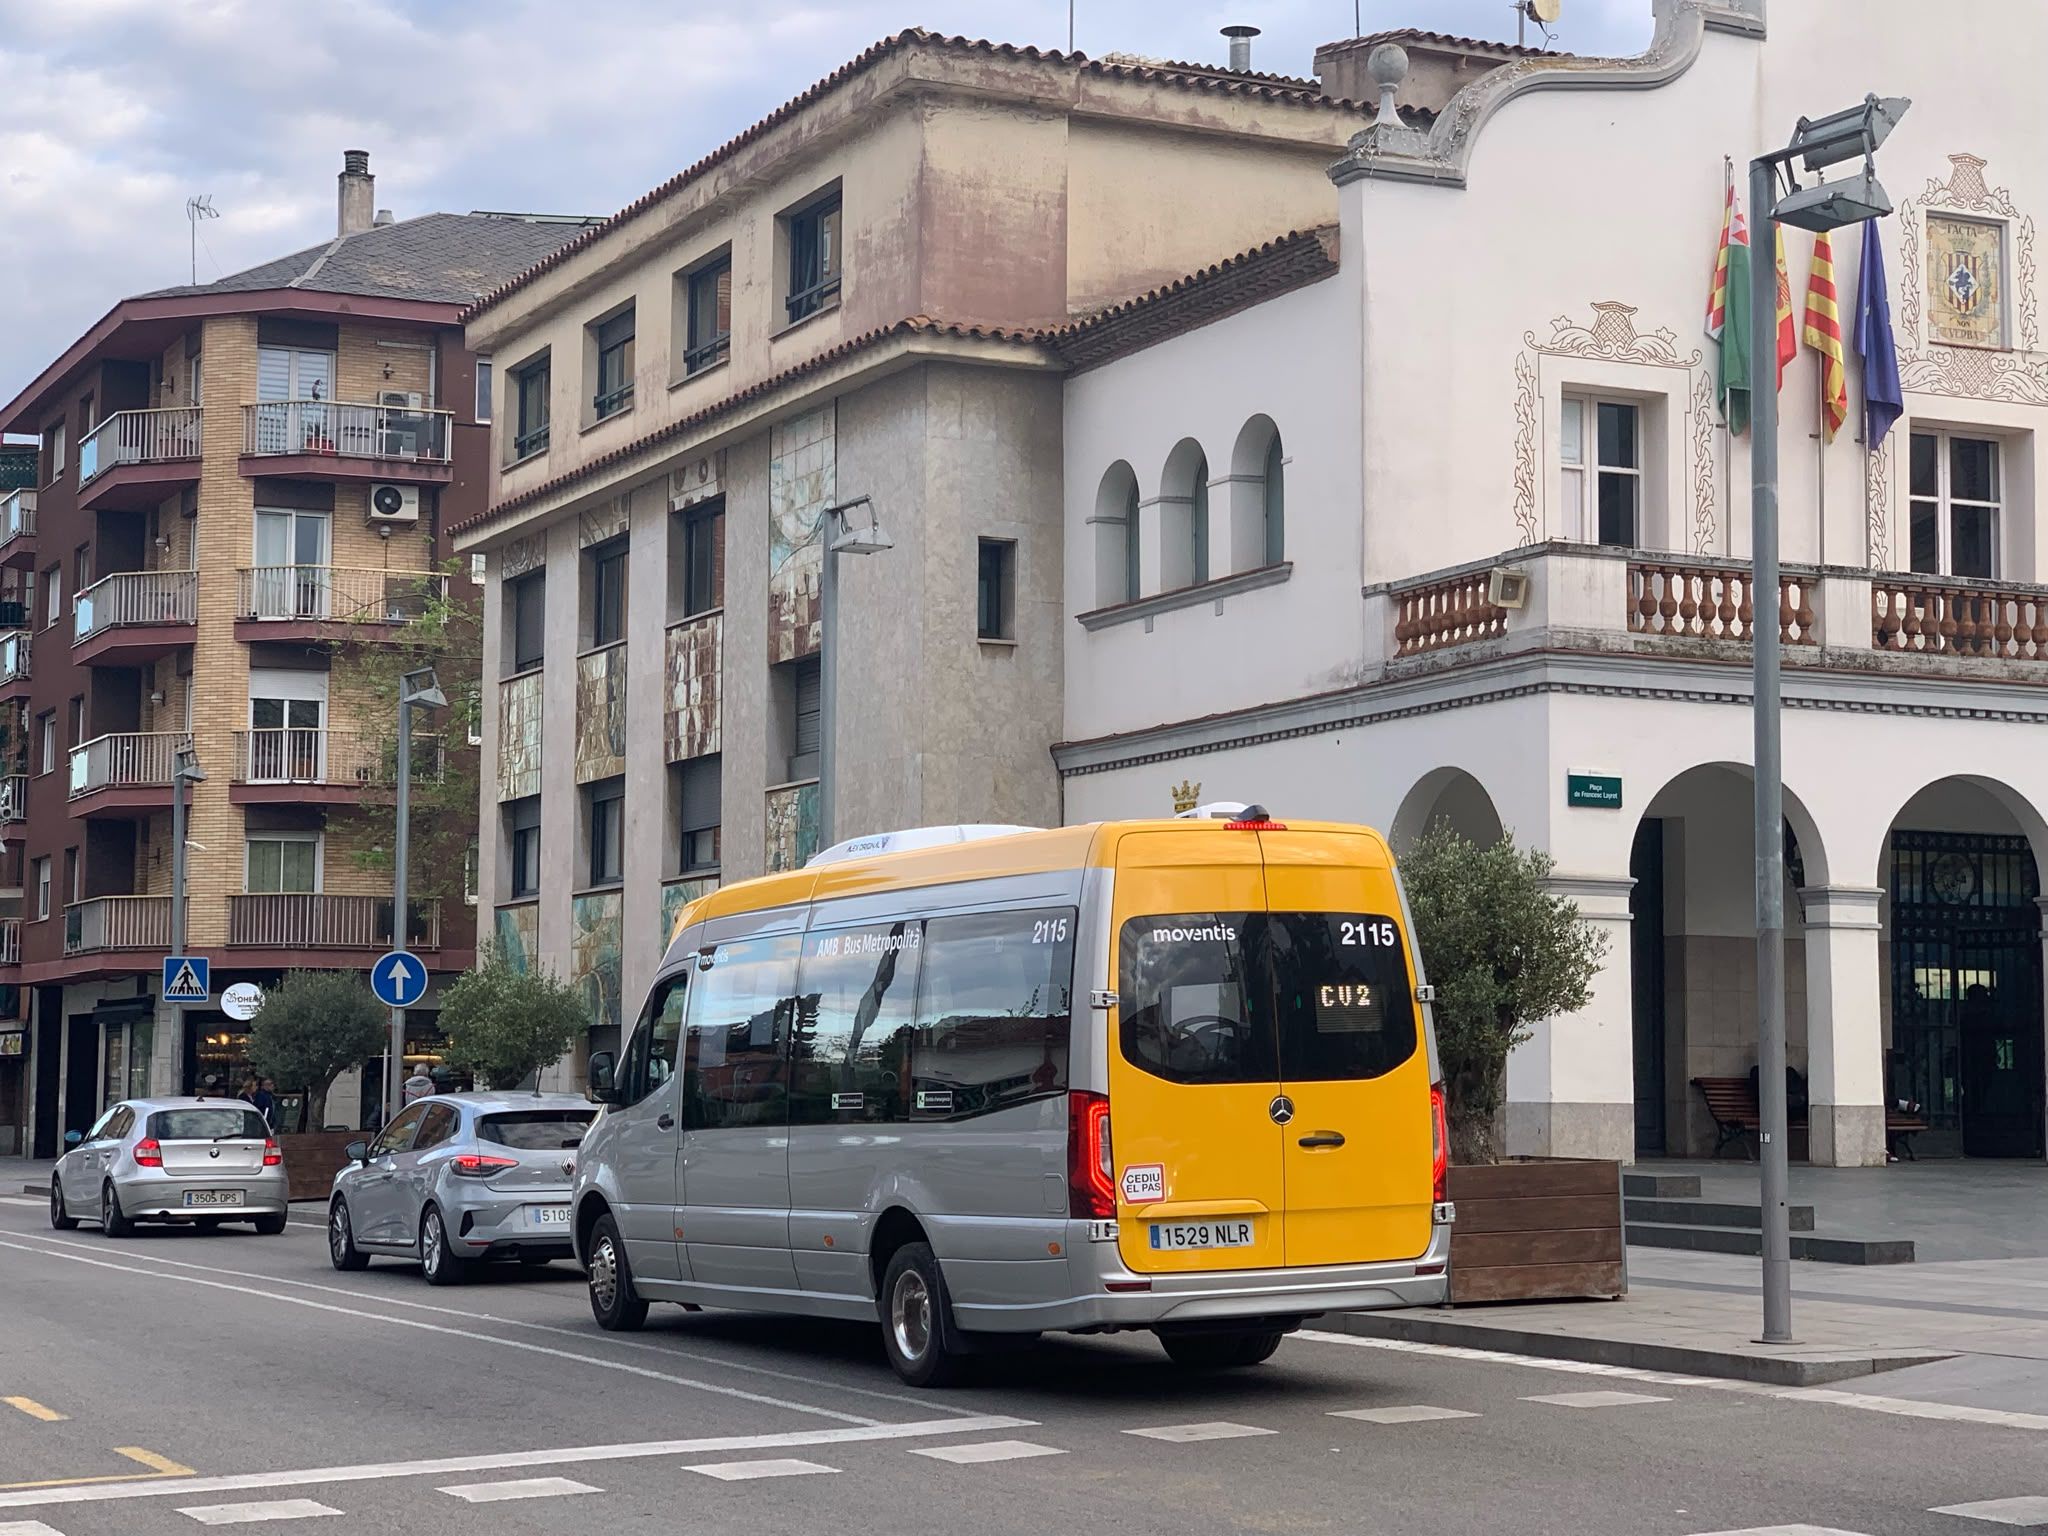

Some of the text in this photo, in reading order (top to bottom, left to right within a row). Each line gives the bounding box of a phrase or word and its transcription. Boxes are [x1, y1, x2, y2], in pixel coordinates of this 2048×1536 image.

[1032, 918, 1067, 944] 2115
[1152, 923, 1236, 943] moventis
[1340, 921, 1395, 947] 2115
[817, 928, 920, 957] AMB Bus Metropolità
[1126, 1172, 1160, 1184] CEDIU
[1126, 1183, 1161, 1193] EL PAS
[194, 1193, 237, 1203] 3505 DPS
[542, 1209, 572, 1222] 5108
[1165, 1224, 1249, 1247] 1529 NLR
